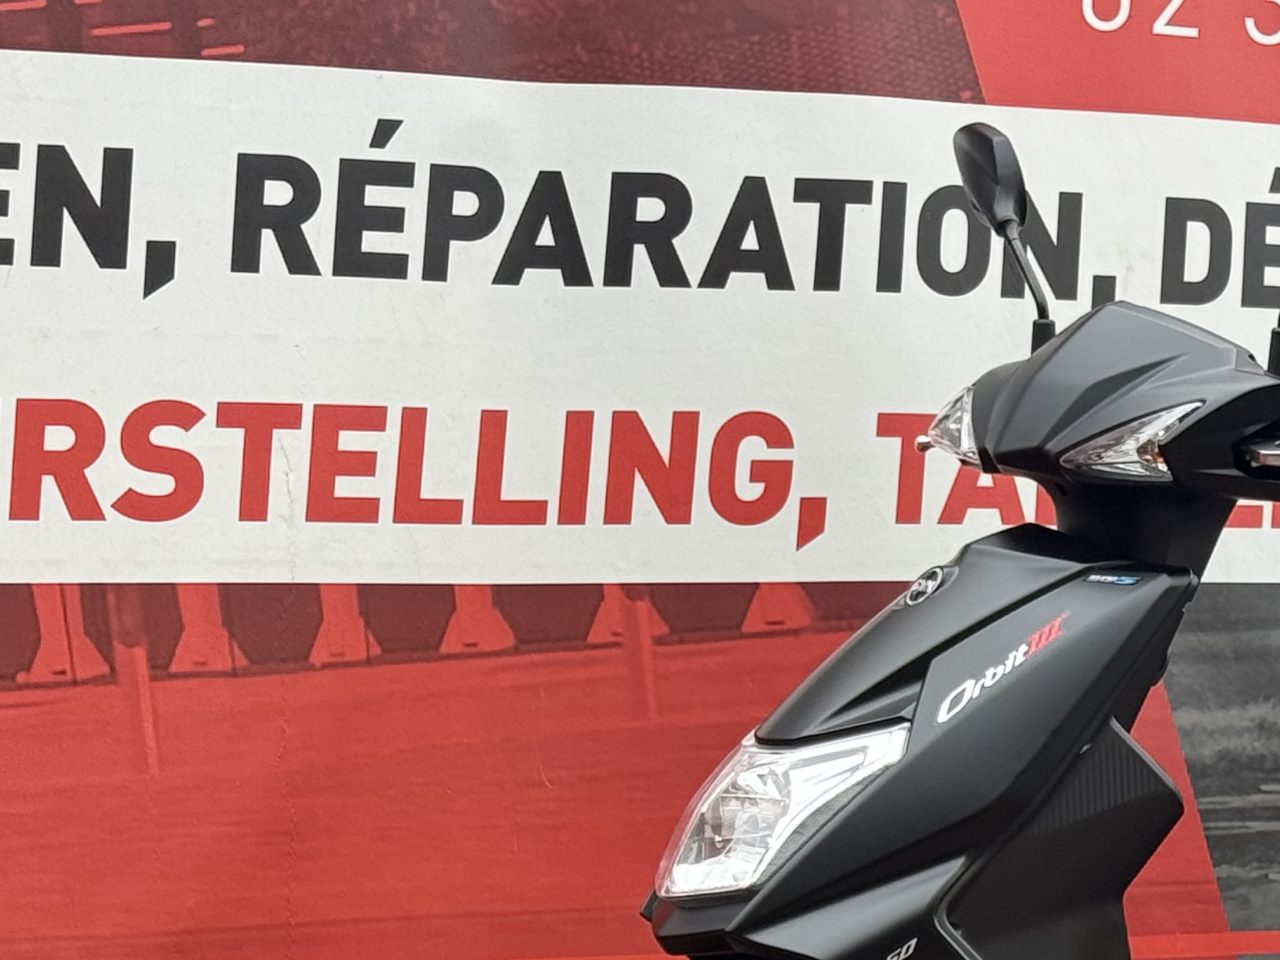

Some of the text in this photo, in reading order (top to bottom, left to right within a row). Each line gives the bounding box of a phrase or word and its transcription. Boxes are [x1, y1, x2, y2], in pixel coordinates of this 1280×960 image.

[0, 142, 178, 300] N,
[229, 118, 1118, 309] RÉPARATION,
[8, 397, 828, 552] RSTELLING,
